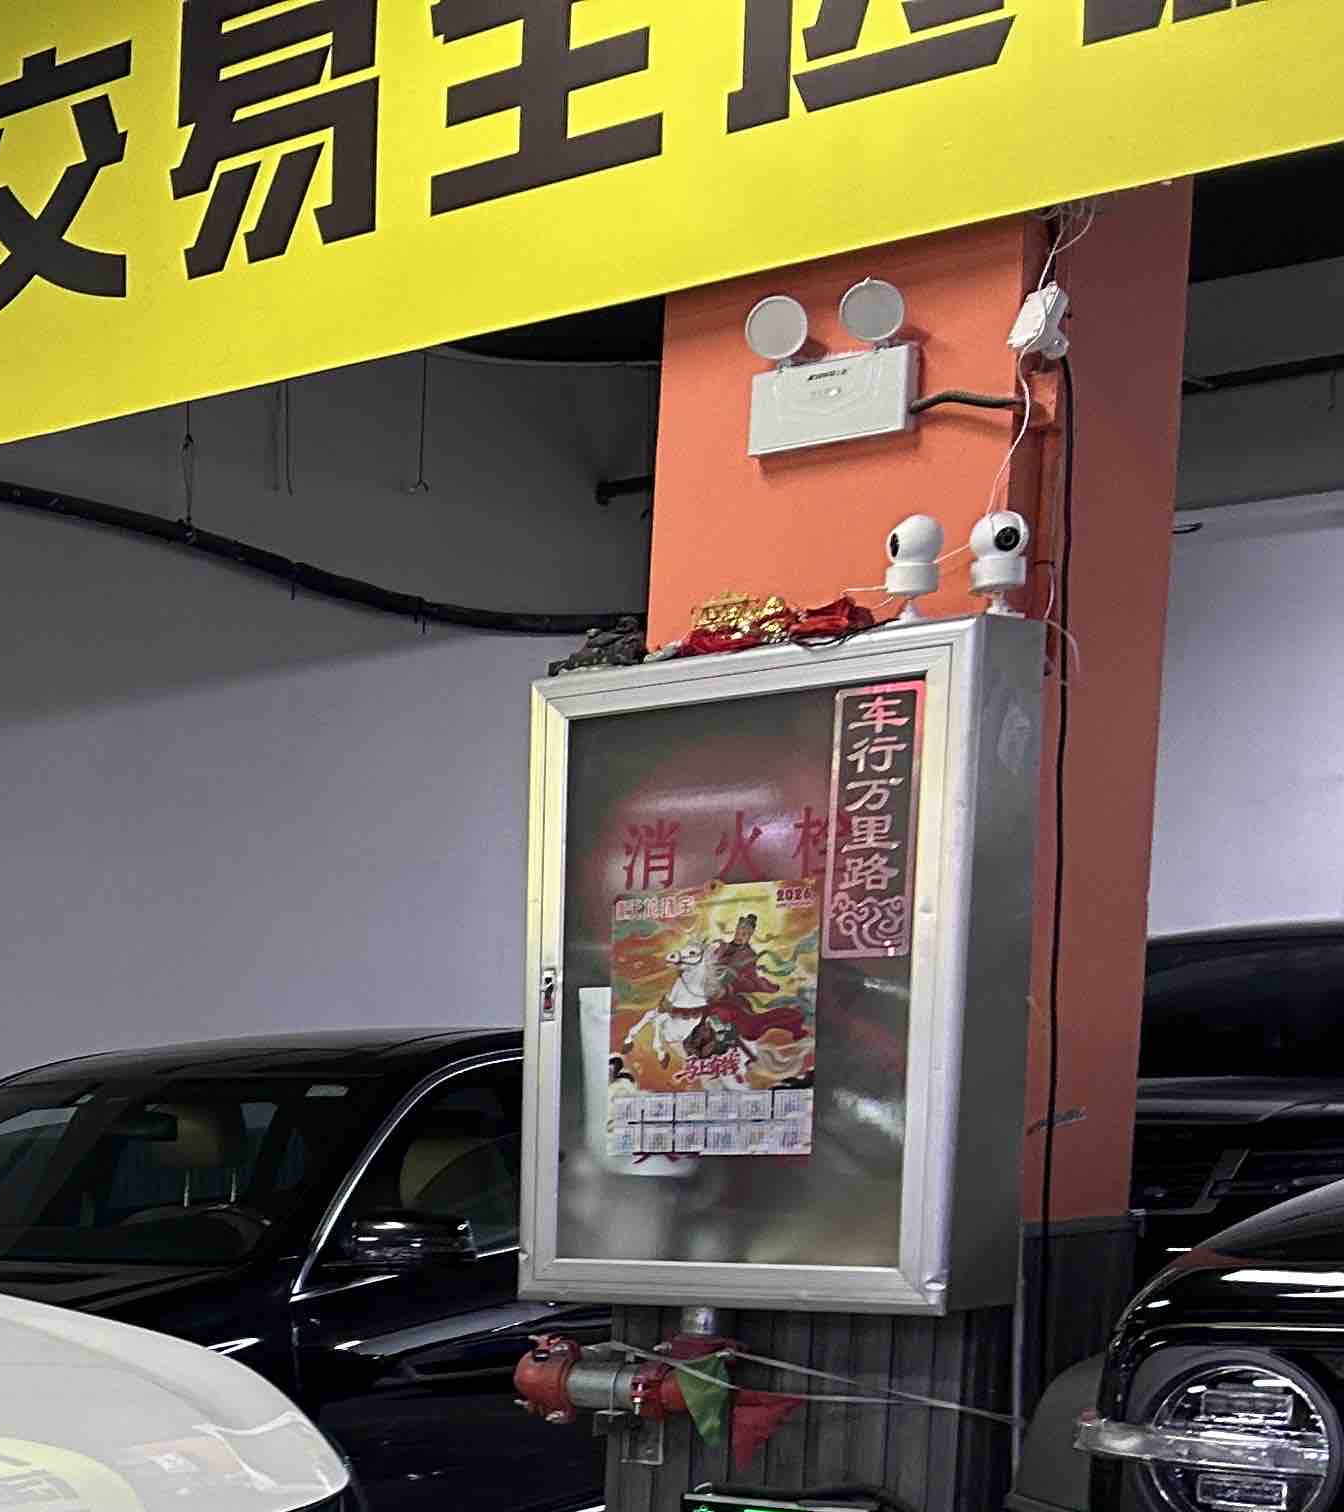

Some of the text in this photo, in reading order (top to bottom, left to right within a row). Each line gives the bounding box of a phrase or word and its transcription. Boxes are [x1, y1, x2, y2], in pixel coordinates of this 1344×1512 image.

[840, 695, 910, 893] 车行万里路
